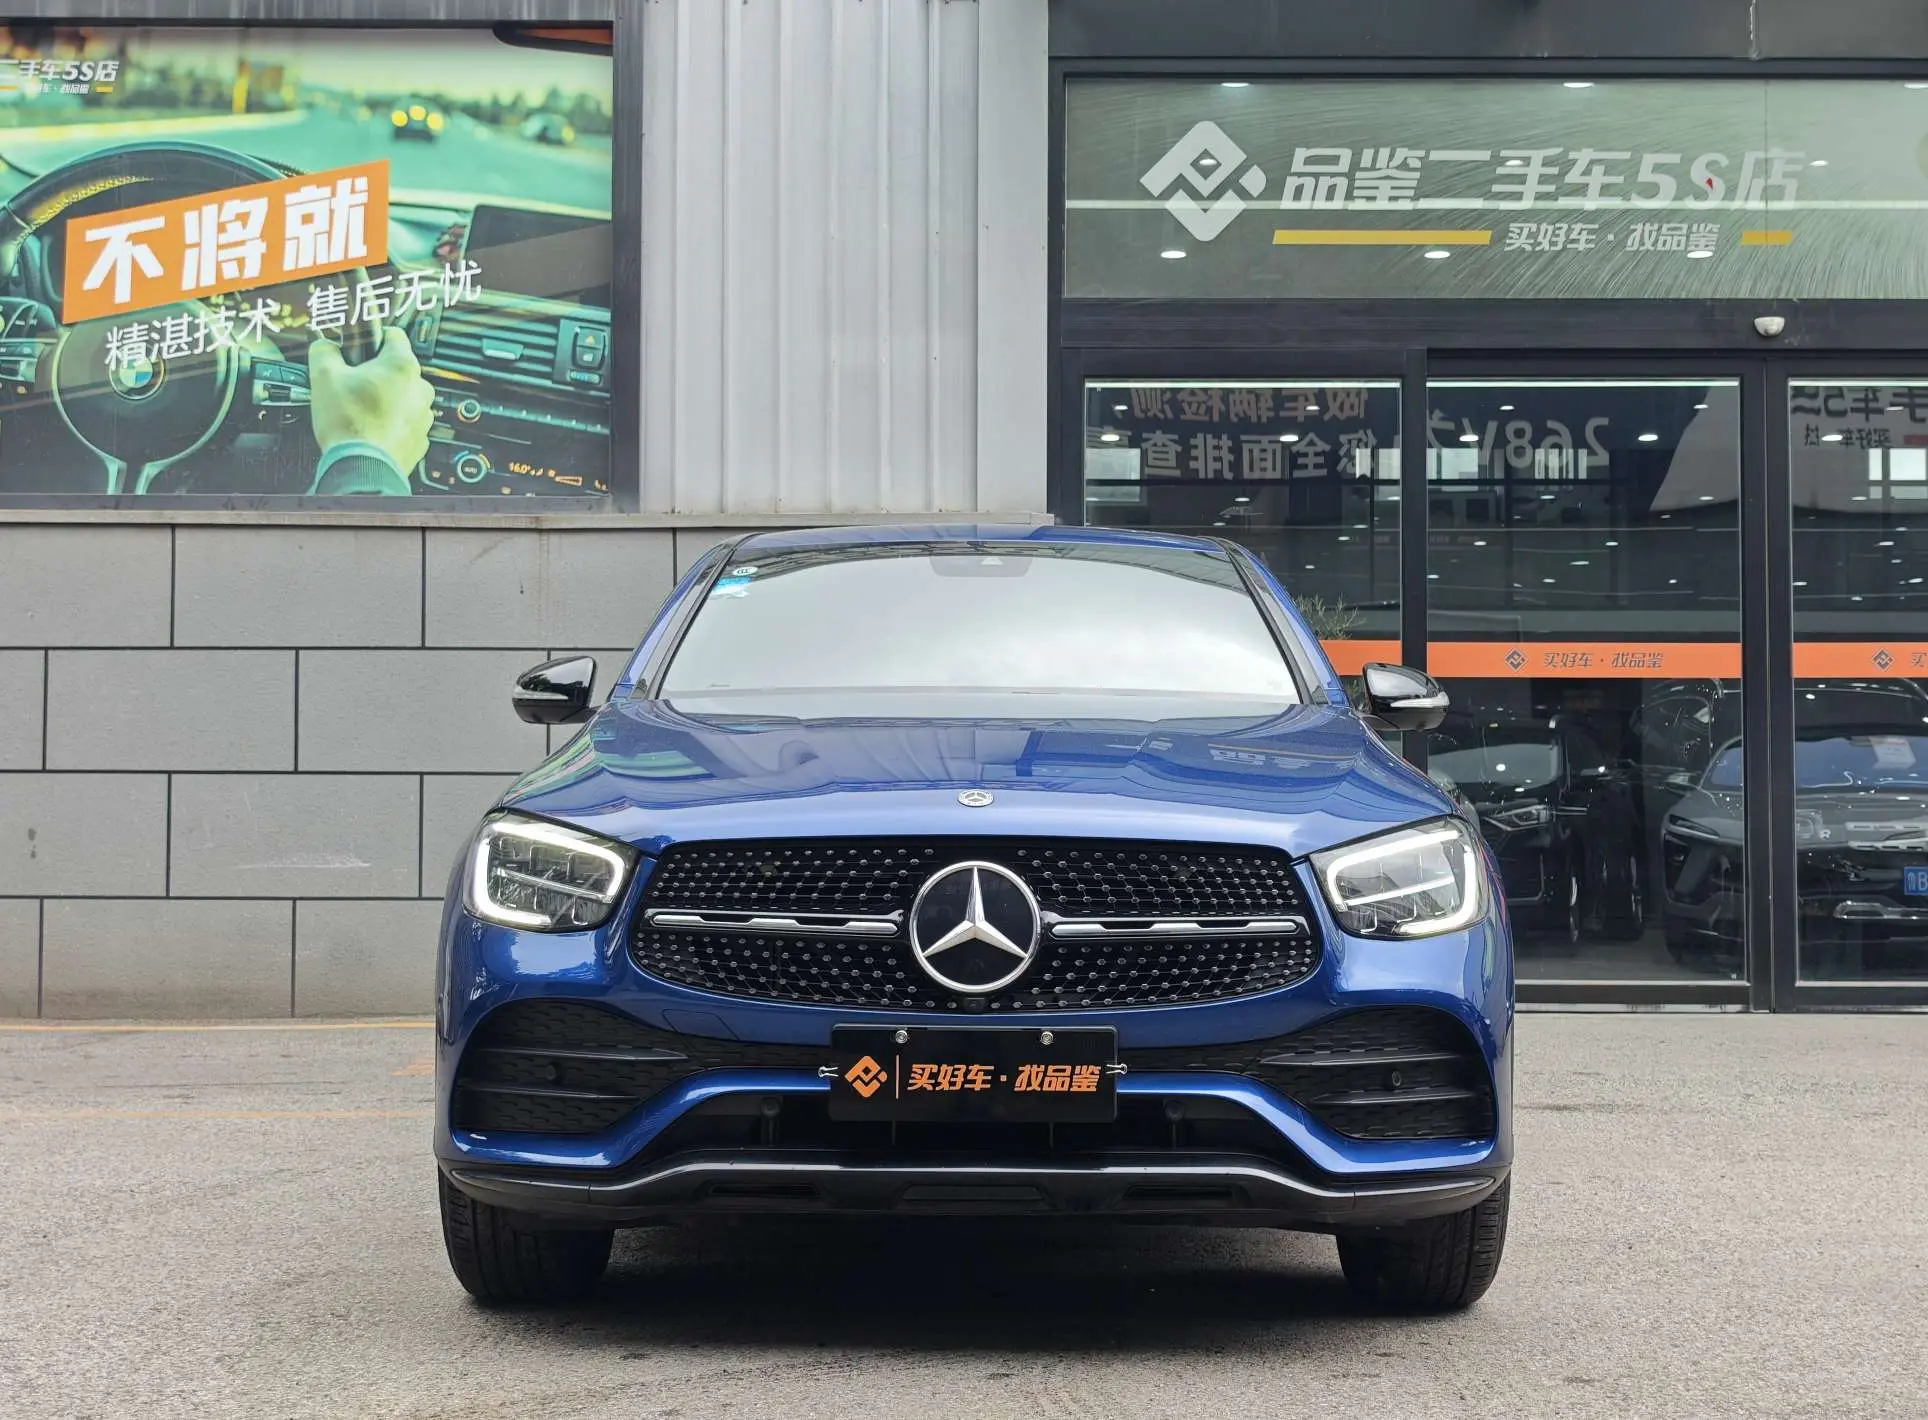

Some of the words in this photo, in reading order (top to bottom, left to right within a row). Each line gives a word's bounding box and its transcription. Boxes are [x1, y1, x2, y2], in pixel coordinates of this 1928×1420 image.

[1279, 147, 1806, 212] 品鉴二手车5S店
[82, 176, 369, 305] 不将就
[104, 298, 282, 372] 精湛技术
[307, 259, 483, 332] 售后无忧
